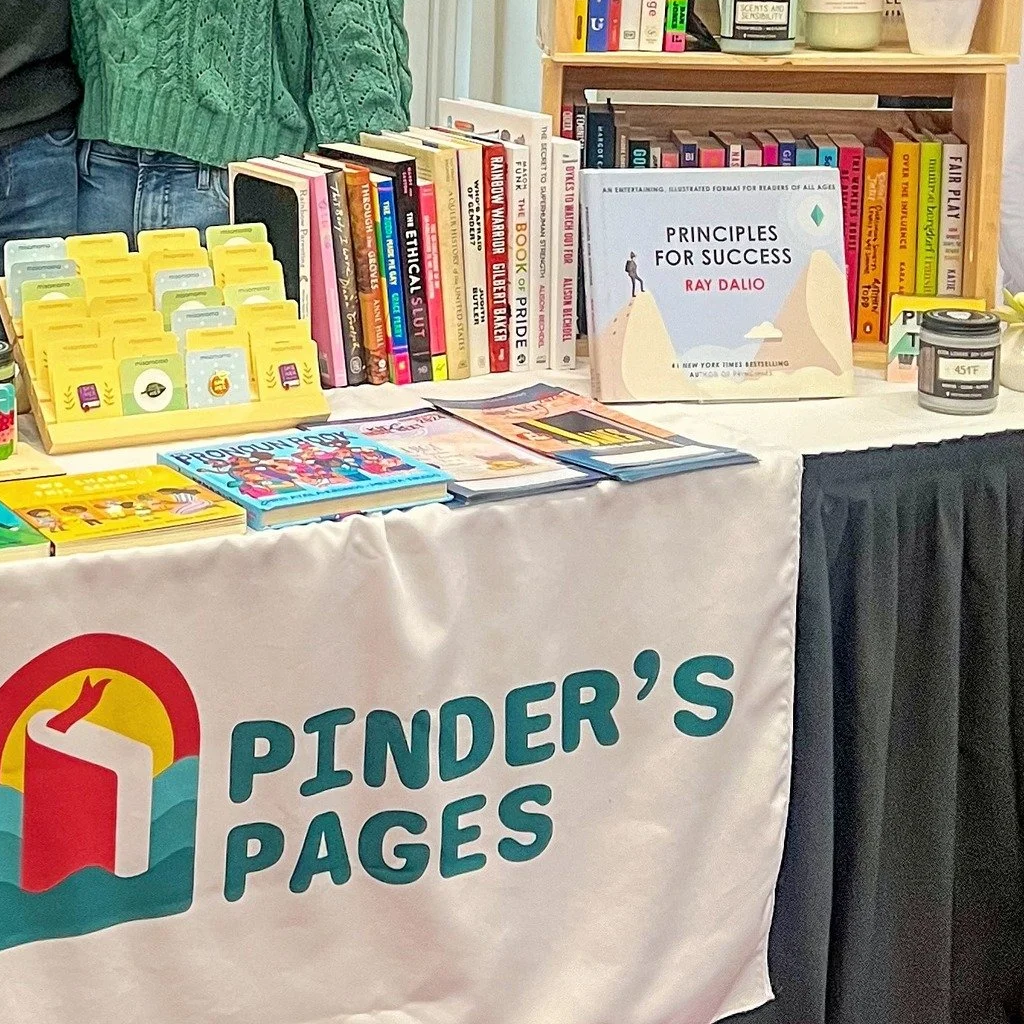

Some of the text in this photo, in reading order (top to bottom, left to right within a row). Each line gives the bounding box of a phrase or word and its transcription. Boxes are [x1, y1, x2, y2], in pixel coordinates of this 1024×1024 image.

[540, 126, 548, 140] THE
[540, 172, 547, 183] TO
[902, 154, 910, 178] OVER
[473, 179, 481, 213] WHO'S
[901, 181, 909, 198] THE
[947, 156, 963, 219] FAIR PLAY
[299, 189, 308, 268] Rainbow Parenting
[468, 187, 476, 246] OF GENDER?
[539, 186, 547, 237] SUPERHUMAN
[563, 165, 575, 264] DYKES TO WATCH OUT FOR
[899, 201, 909, 250] INFLUENCE
[490, 155, 507, 343] RAINBOW WARRIOR GILBERT BAKER
[666, 225, 778, 243] PRINCIPLES
[405, 212, 425, 338] THE ETHICAL SLUT
[515, 198, 527, 349] THE BOOK OF PRIDE
[655, 248, 792, 266] FOR SUCCESS
[538, 285, 546, 313] ALISON
[685, 278, 765, 292] RAY DALIO
[946, 269, 956, 291] KATIE
[472, 287, 480, 325] BUTLER
[175, 431, 359, 466] PRONOUN BOOK
[229, 649, 735, 804] PINDER'S
[223, 783, 554, 902] PAGES
